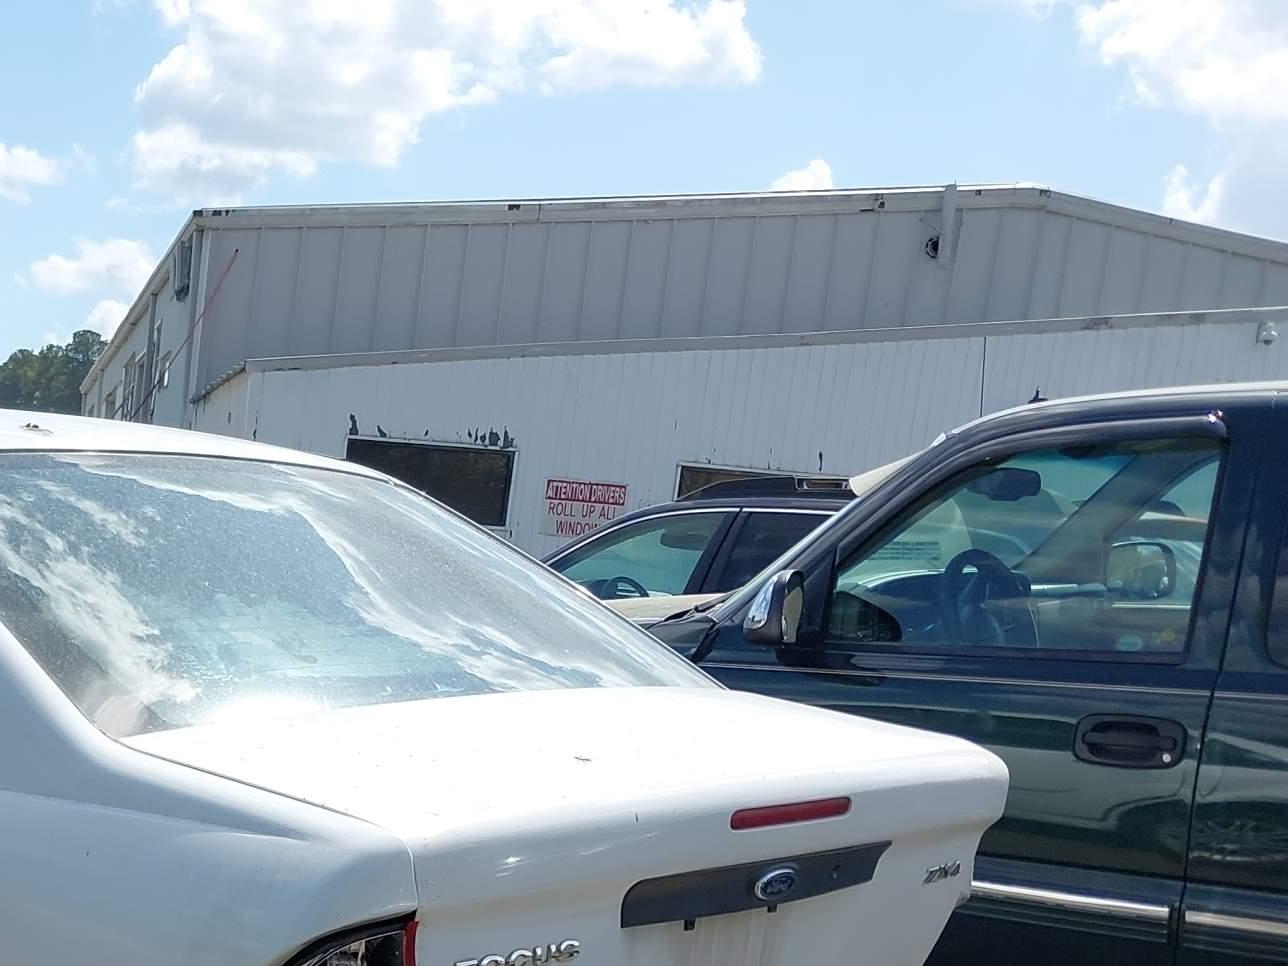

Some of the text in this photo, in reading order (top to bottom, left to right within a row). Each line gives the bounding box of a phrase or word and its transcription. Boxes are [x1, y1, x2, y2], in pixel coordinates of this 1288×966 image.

[546, 481, 626, 504] ATTENTION DRIVERS
[548, 502, 575, 517] ROLL
[581, 504, 596, 518] UP
